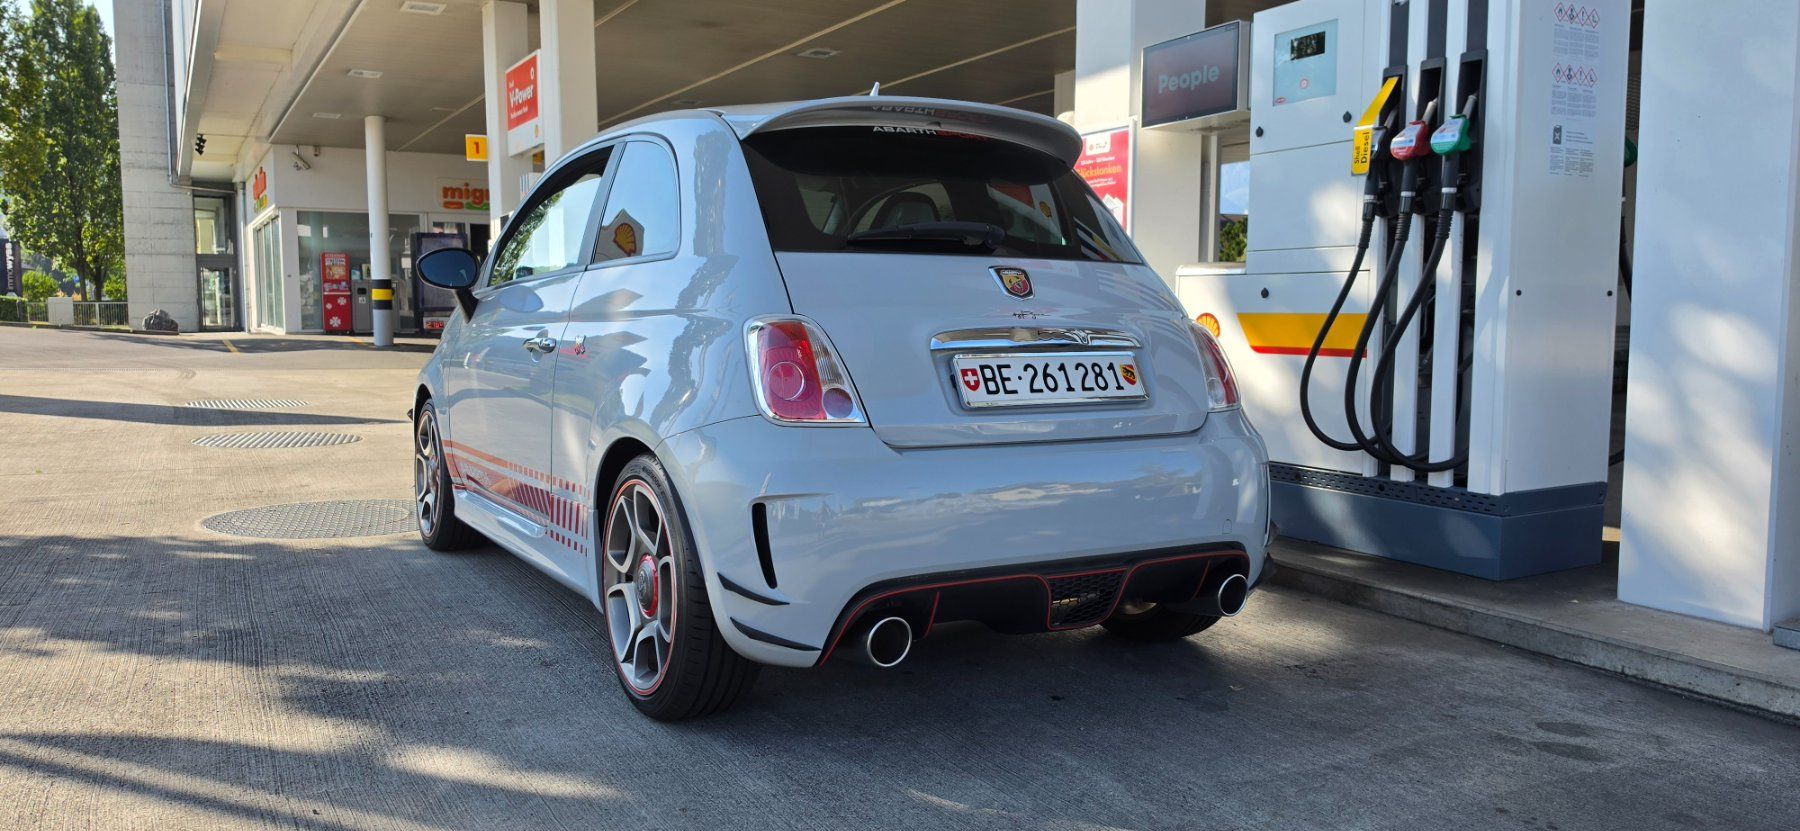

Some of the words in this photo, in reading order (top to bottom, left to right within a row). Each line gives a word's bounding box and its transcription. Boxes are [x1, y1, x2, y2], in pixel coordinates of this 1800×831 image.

[1157, 64, 1220, 94] People
[509, 84, 534, 108] V-Power
[872, 126, 937, 136] ABARTH
[473, 141, 480, 155] 1
[1360, 131, 1370, 164] Diesel
